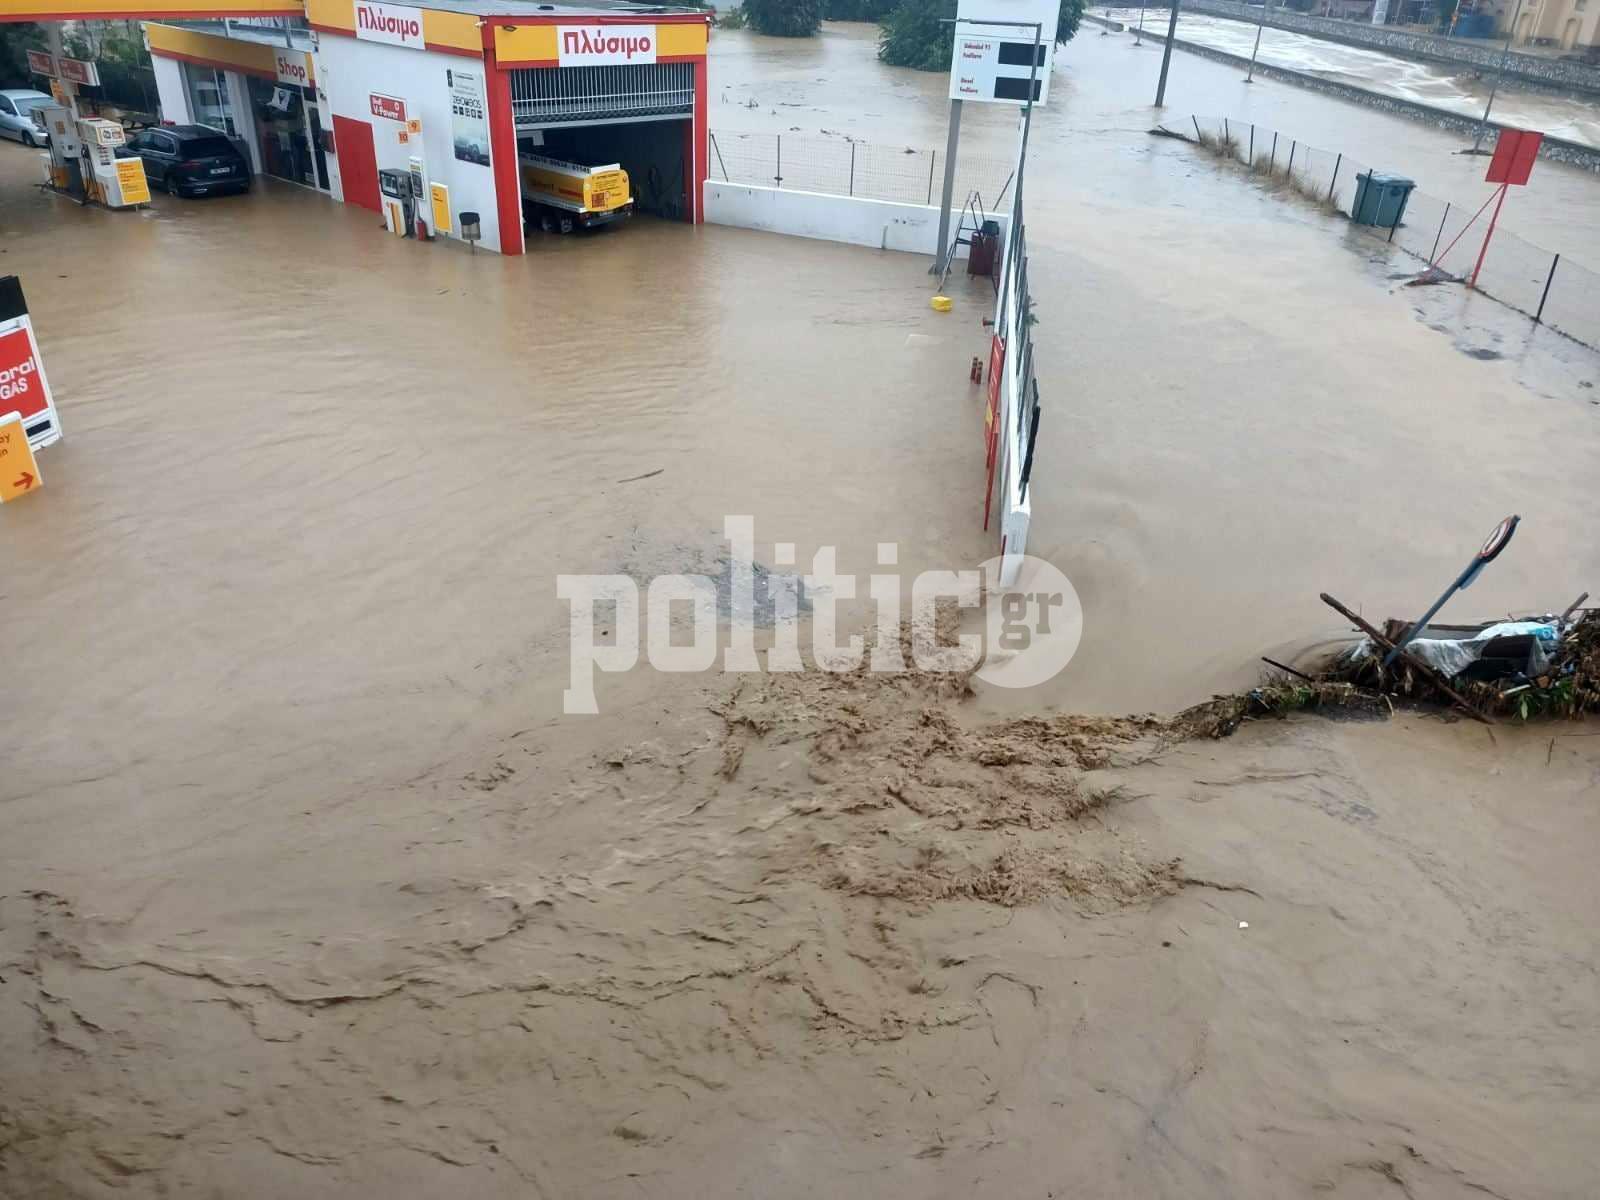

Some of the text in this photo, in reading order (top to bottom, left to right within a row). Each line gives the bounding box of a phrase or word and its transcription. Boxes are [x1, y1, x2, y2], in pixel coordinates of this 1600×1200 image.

[358, 6, 419, 41] Πλύσιμο
[563, 29, 651, 59] Πλύσιμο
[278, 56, 306, 81] Shop
[0, 356, 36, 383] oral
[0, 377, 28, 400] GAS
[0, 433, 10, 445] ay
